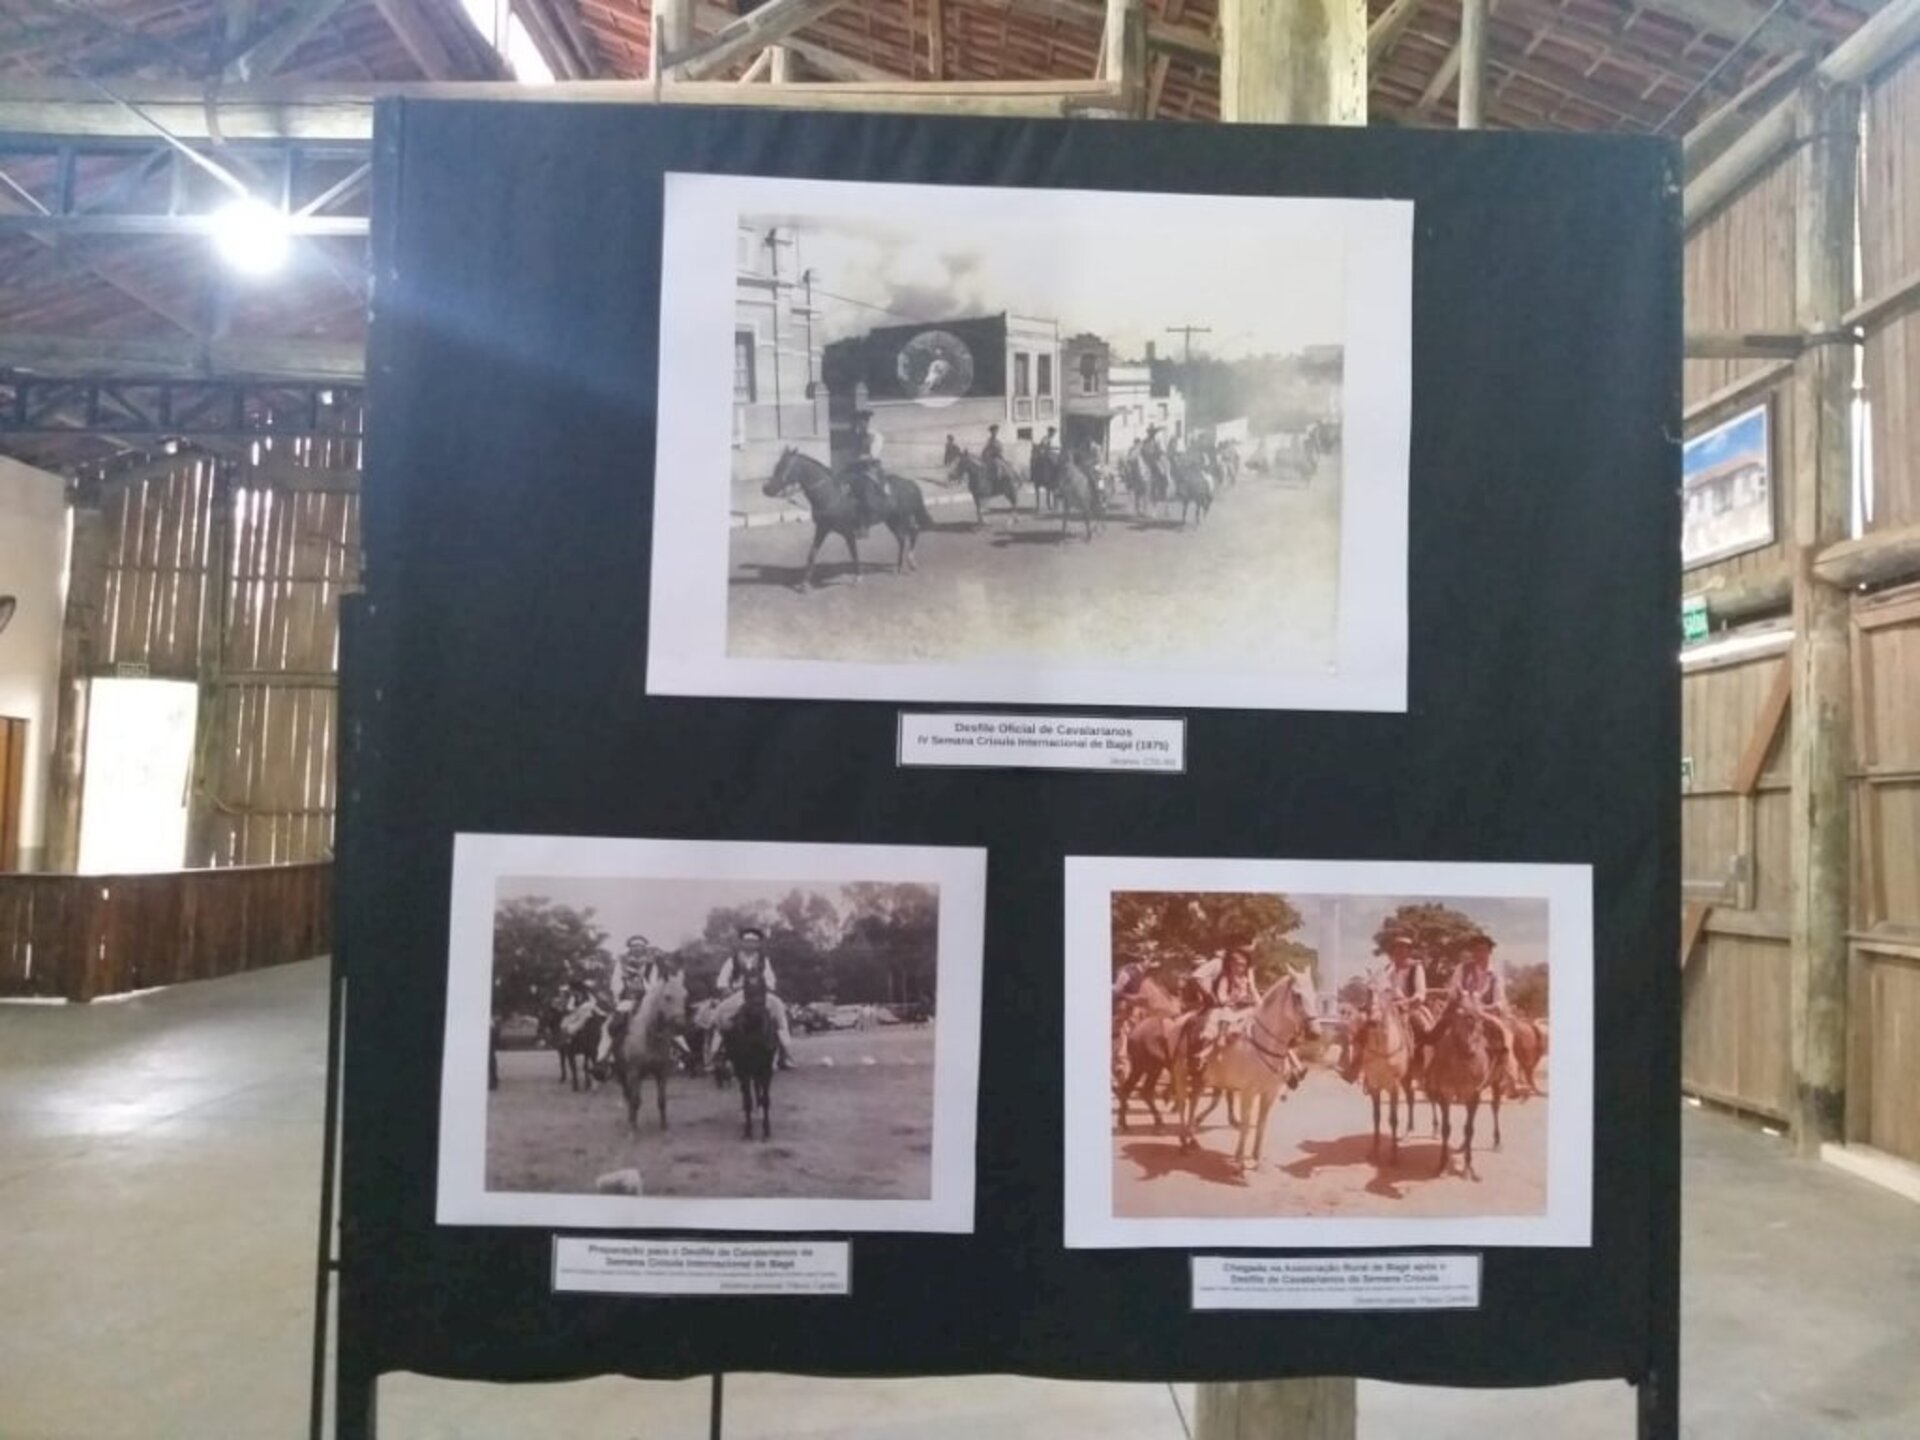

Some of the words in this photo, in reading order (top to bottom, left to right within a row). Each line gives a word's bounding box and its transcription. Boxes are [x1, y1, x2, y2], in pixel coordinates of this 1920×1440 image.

[955, 722, 994, 733] Desfile
[998, 723, 1036, 735] Oficial
[1039, 724, 1053, 735] de
[1056, 725, 1133, 737] Cavalarianos
[931, 736, 974, 746] Semana
[1018, 737, 1087, 748] Internacional
[1090, 739, 1103, 749] de
